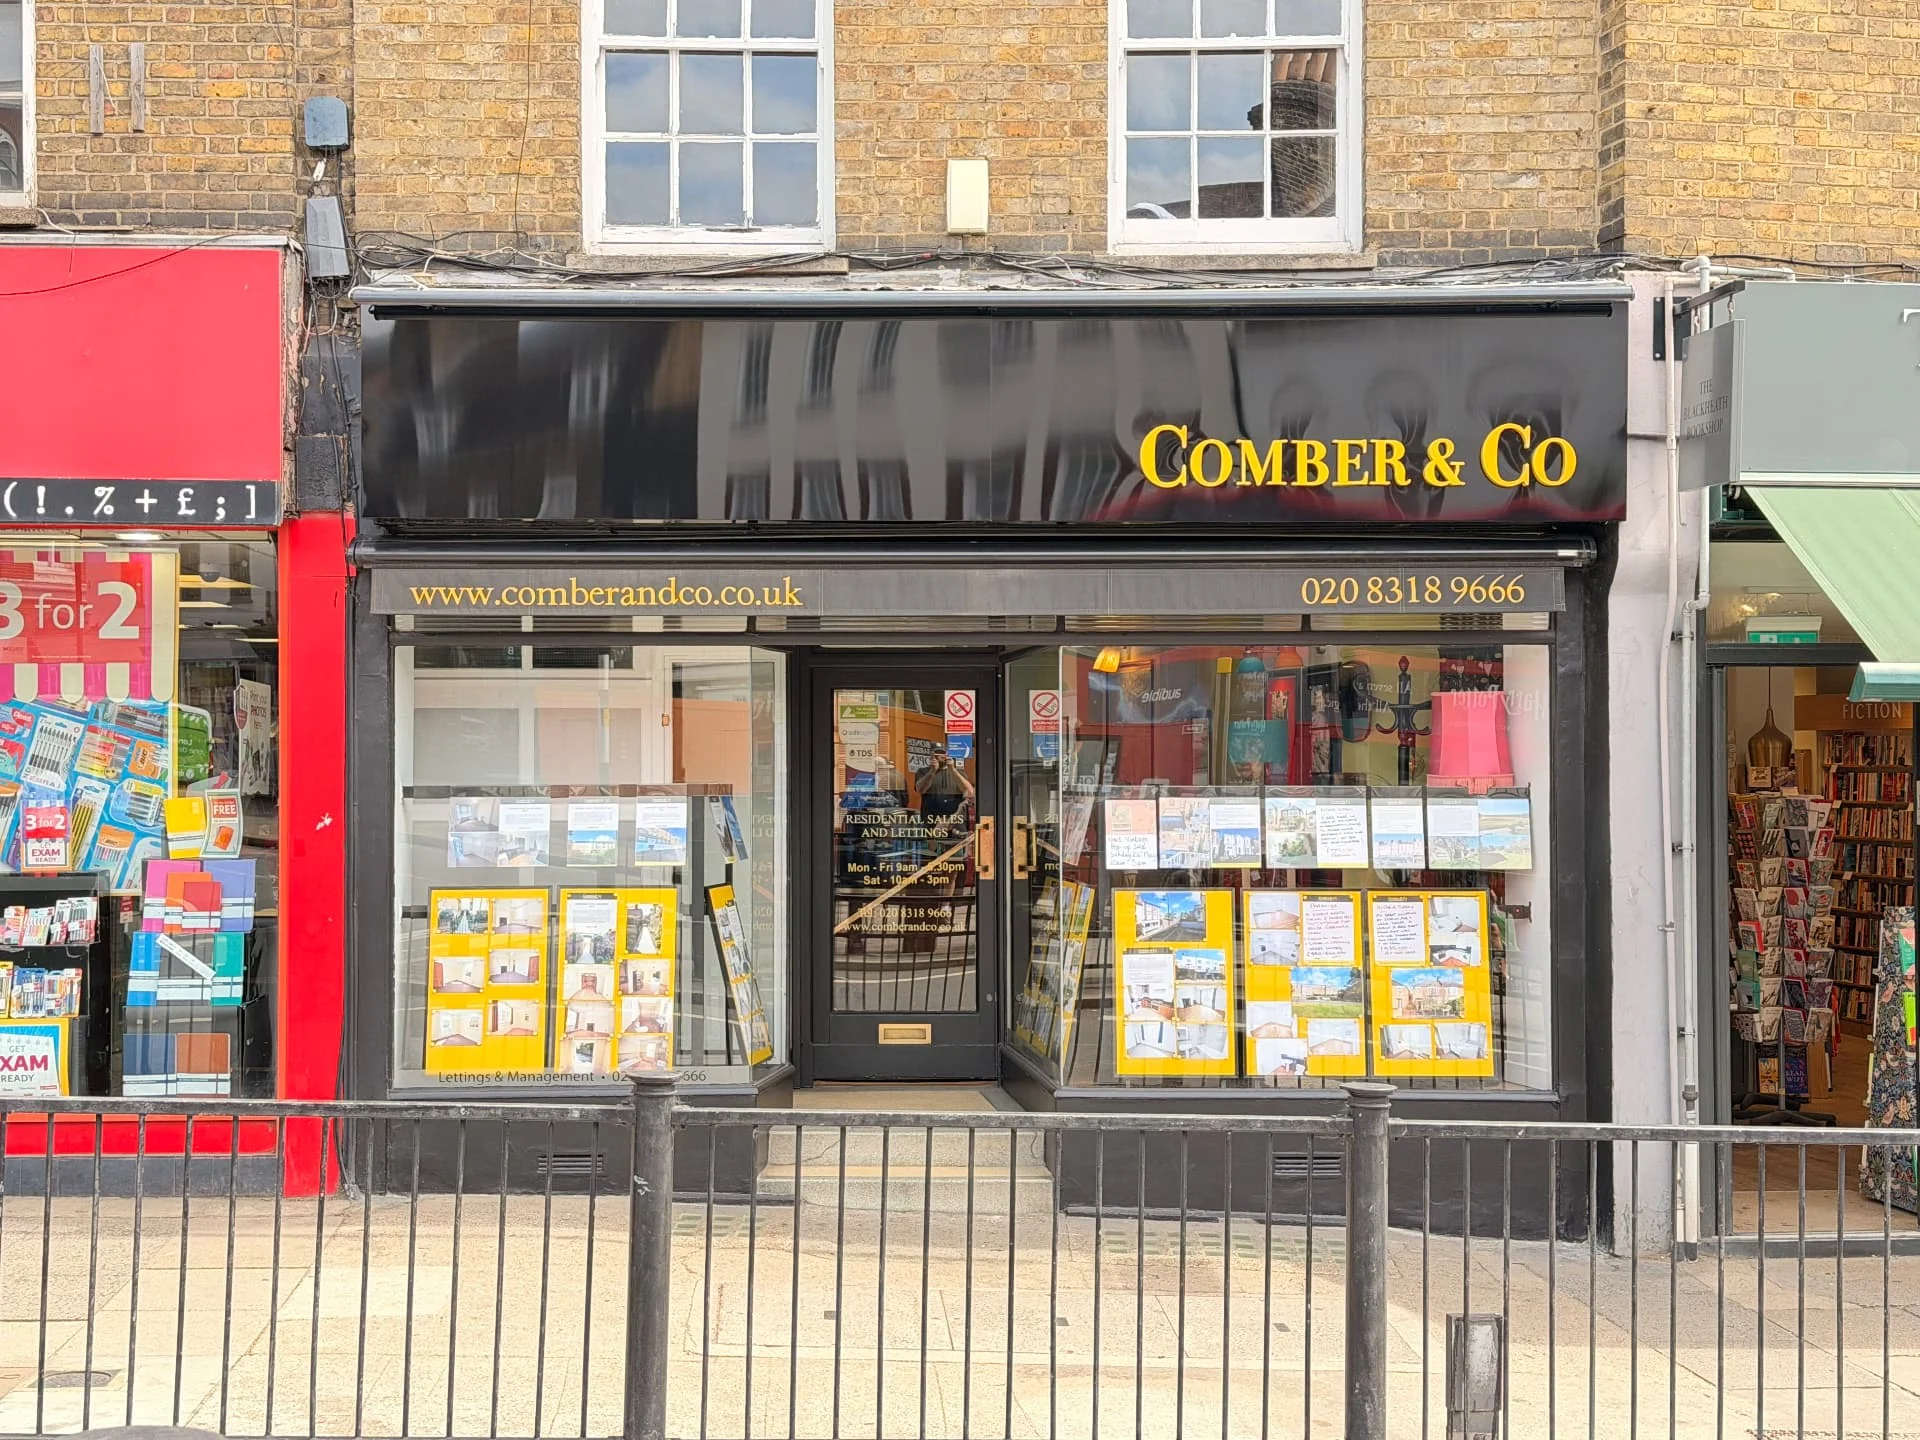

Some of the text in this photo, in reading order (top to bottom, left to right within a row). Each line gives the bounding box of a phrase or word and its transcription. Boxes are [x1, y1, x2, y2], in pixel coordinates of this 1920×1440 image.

[1699, 378, 1713, 396] THE
[1139, 423, 1577, 488] COMBER & CO
[409, 577, 804, 607] www.comberandco.co.uk
[1301, 573, 1525, 605] 020 8318 9666
[0, 581, 140, 640] 3 for 2
[1842, 702, 1902, 720] FICTION
[213, 804, 237, 815] FREE
[25, 815, 37, 830] 3
[55, 814, 65, 830] 2
[846, 814, 964, 825] RESIDENTIAL SALES
[861, 828, 949, 838] AND LETTINGS
[32, 849, 61, 857] EXAM
[847, 863, 870, 872] Mon
[880, 863, 893, 872] Fri
[896, 862, 918, 872] 9am
[863, 875, 880, 885] Sat
[927, 875, 950, 887] 3pm
[879, 908, 899, 918] 020
[900, 907, 925, 918] 8318
[927, 907, 952, 918] 9666
[845, 921, 966, 932] www.comberandco.co.uk
[9, 1045, 25, 1053] GET
[0, 1055, 49, 1072] XAM
[1, 1074, 35, 1082] READY
[438, 1070, 492, 1084] Lettings
[494, 1071, 504, 1082] &
[507, 1071, 594, 1084] Management
[679, 1071, 706, 1082] 666
